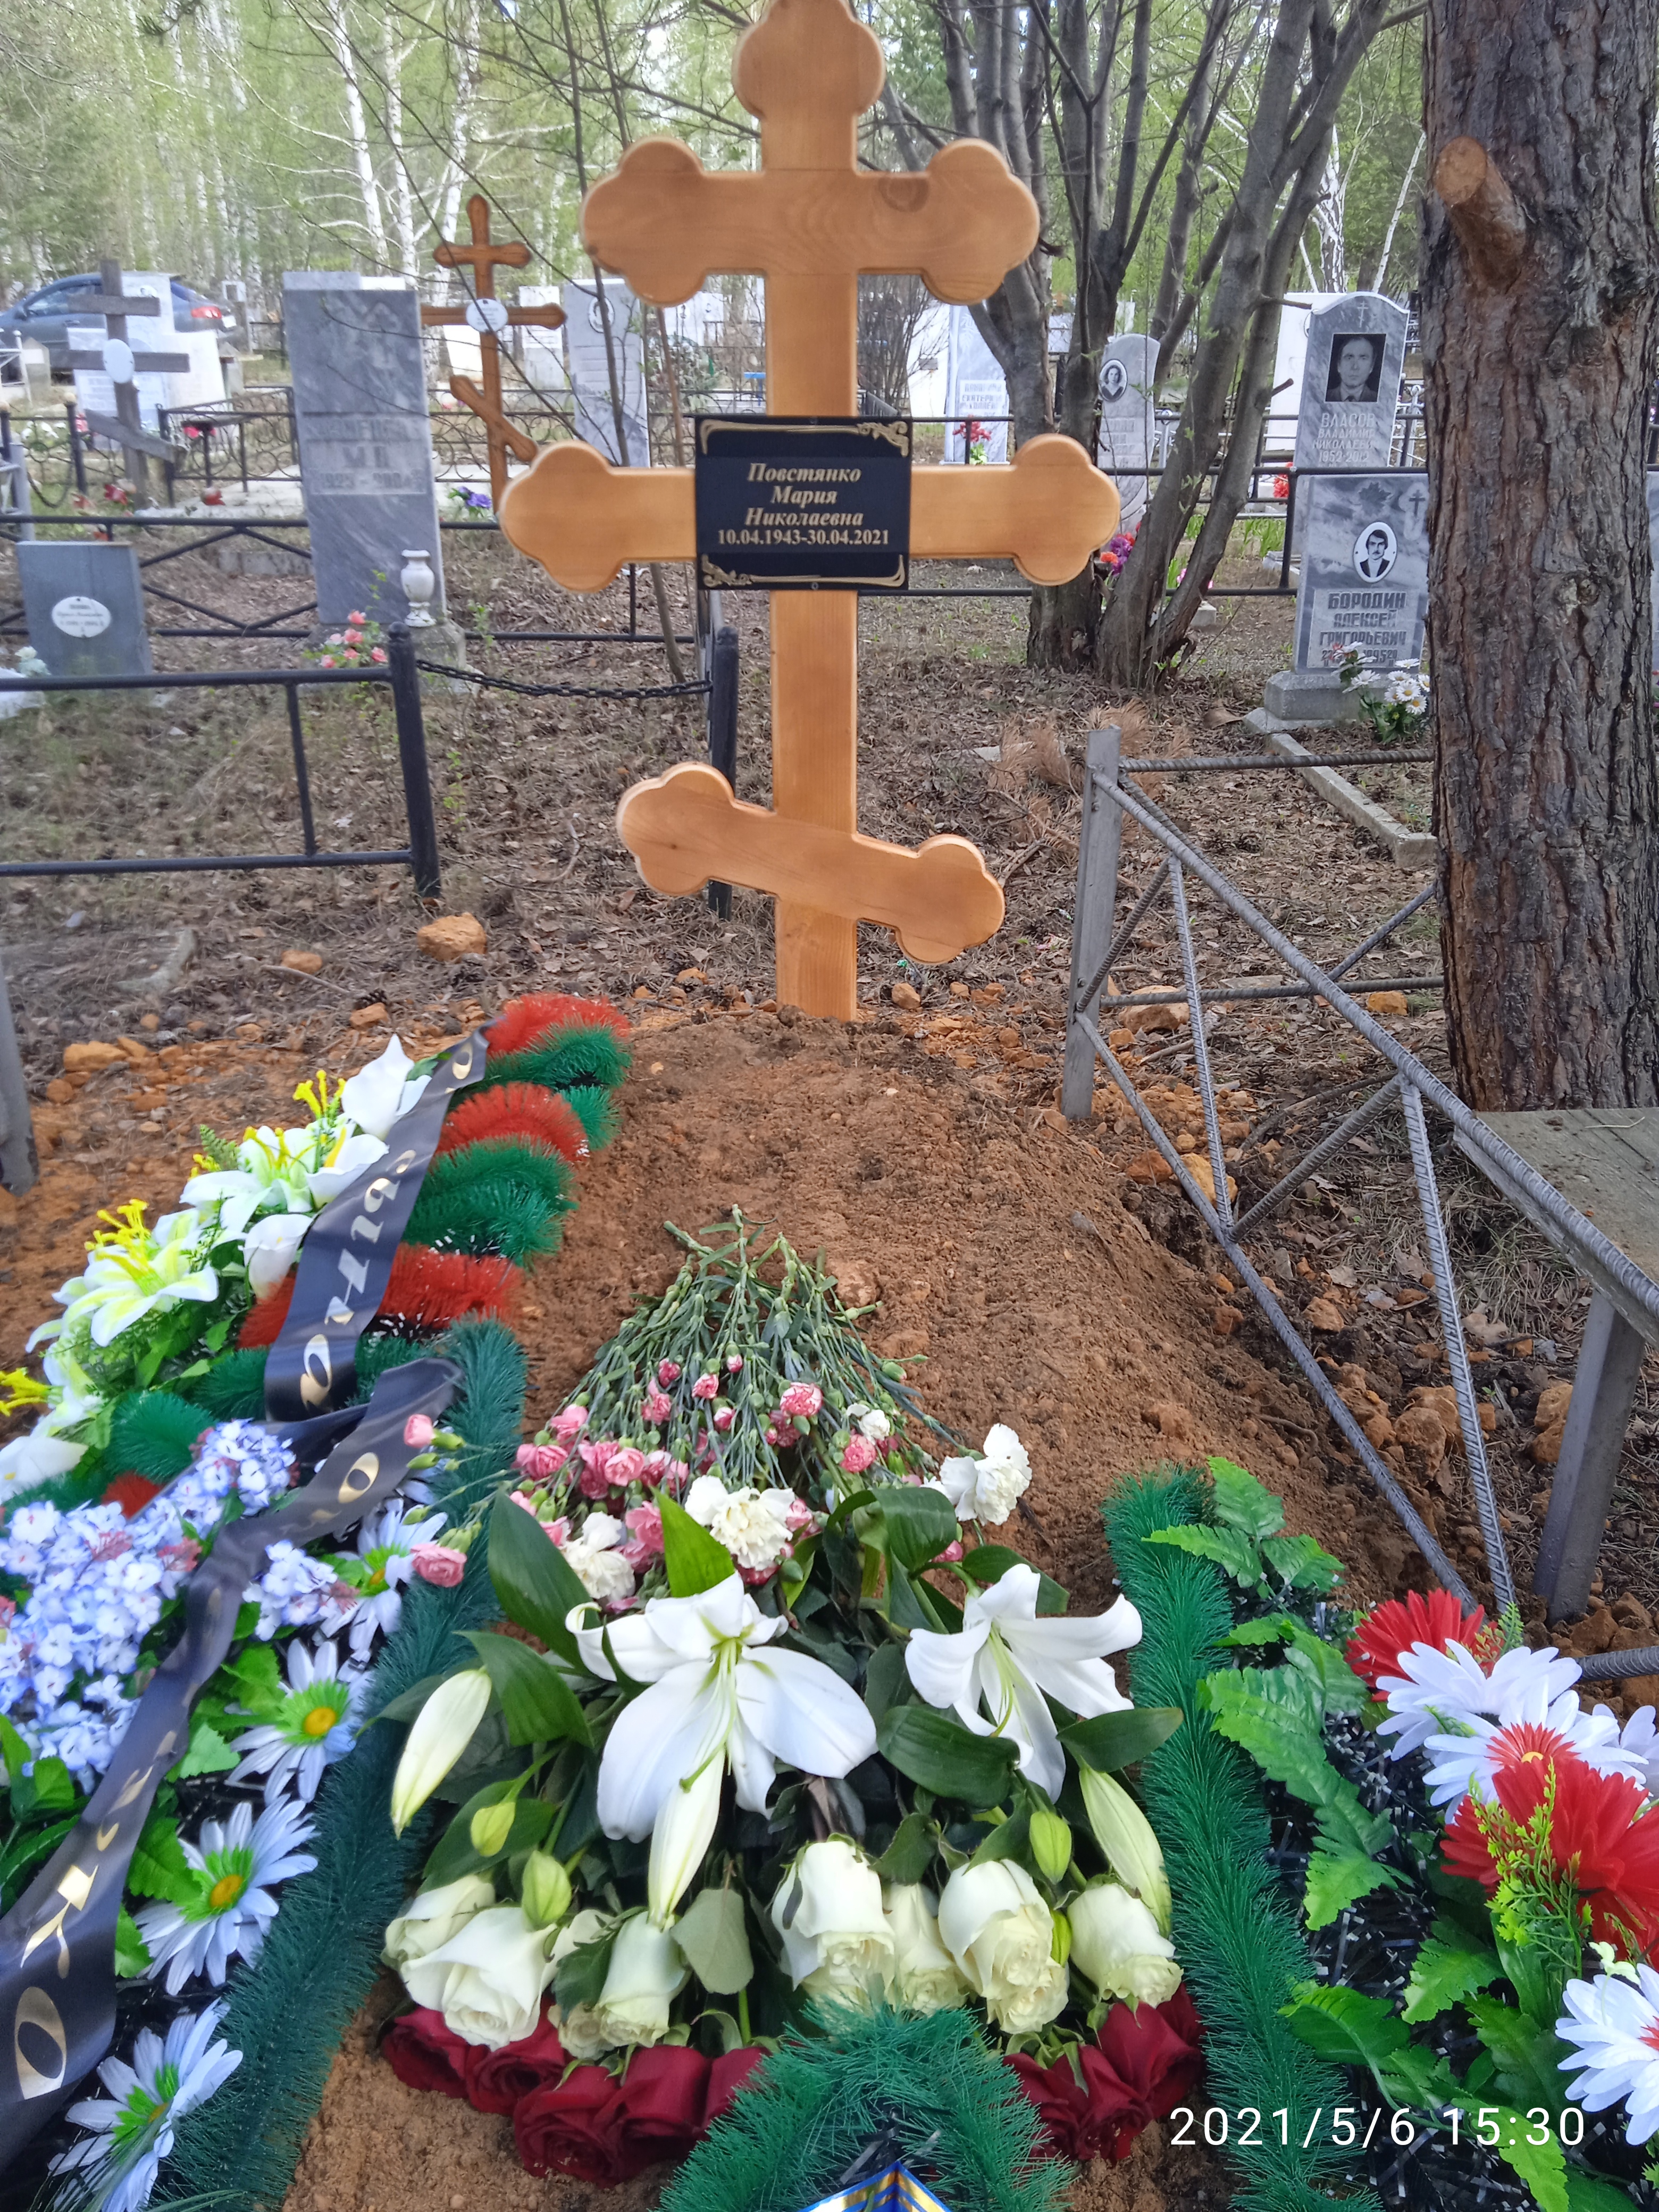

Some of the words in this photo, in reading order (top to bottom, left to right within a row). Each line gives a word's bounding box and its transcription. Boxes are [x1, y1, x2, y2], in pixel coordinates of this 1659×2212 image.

[1321, 413, 1376, 428] ВЛАСОВ
[1318, 428, 1376, 439] ВЛАДИМИР
[1313, 439, 1379, 450] НИКОЛАЕВ
[747, 463, 862, 482] Повстянко
[770, 485, 838, 509] Мария
[745, 507, 864, 526] Николаевна
[718, 529, 889, 546] 10.04.1943-30.04.2021
[1328, 592, 1407, 609] БОРОДИН
[1334, 609, 1397, 628] АЛЕКСЕЙ
[1320, 631, 1407, 646] ГРИГОРЬЕВИЧ
